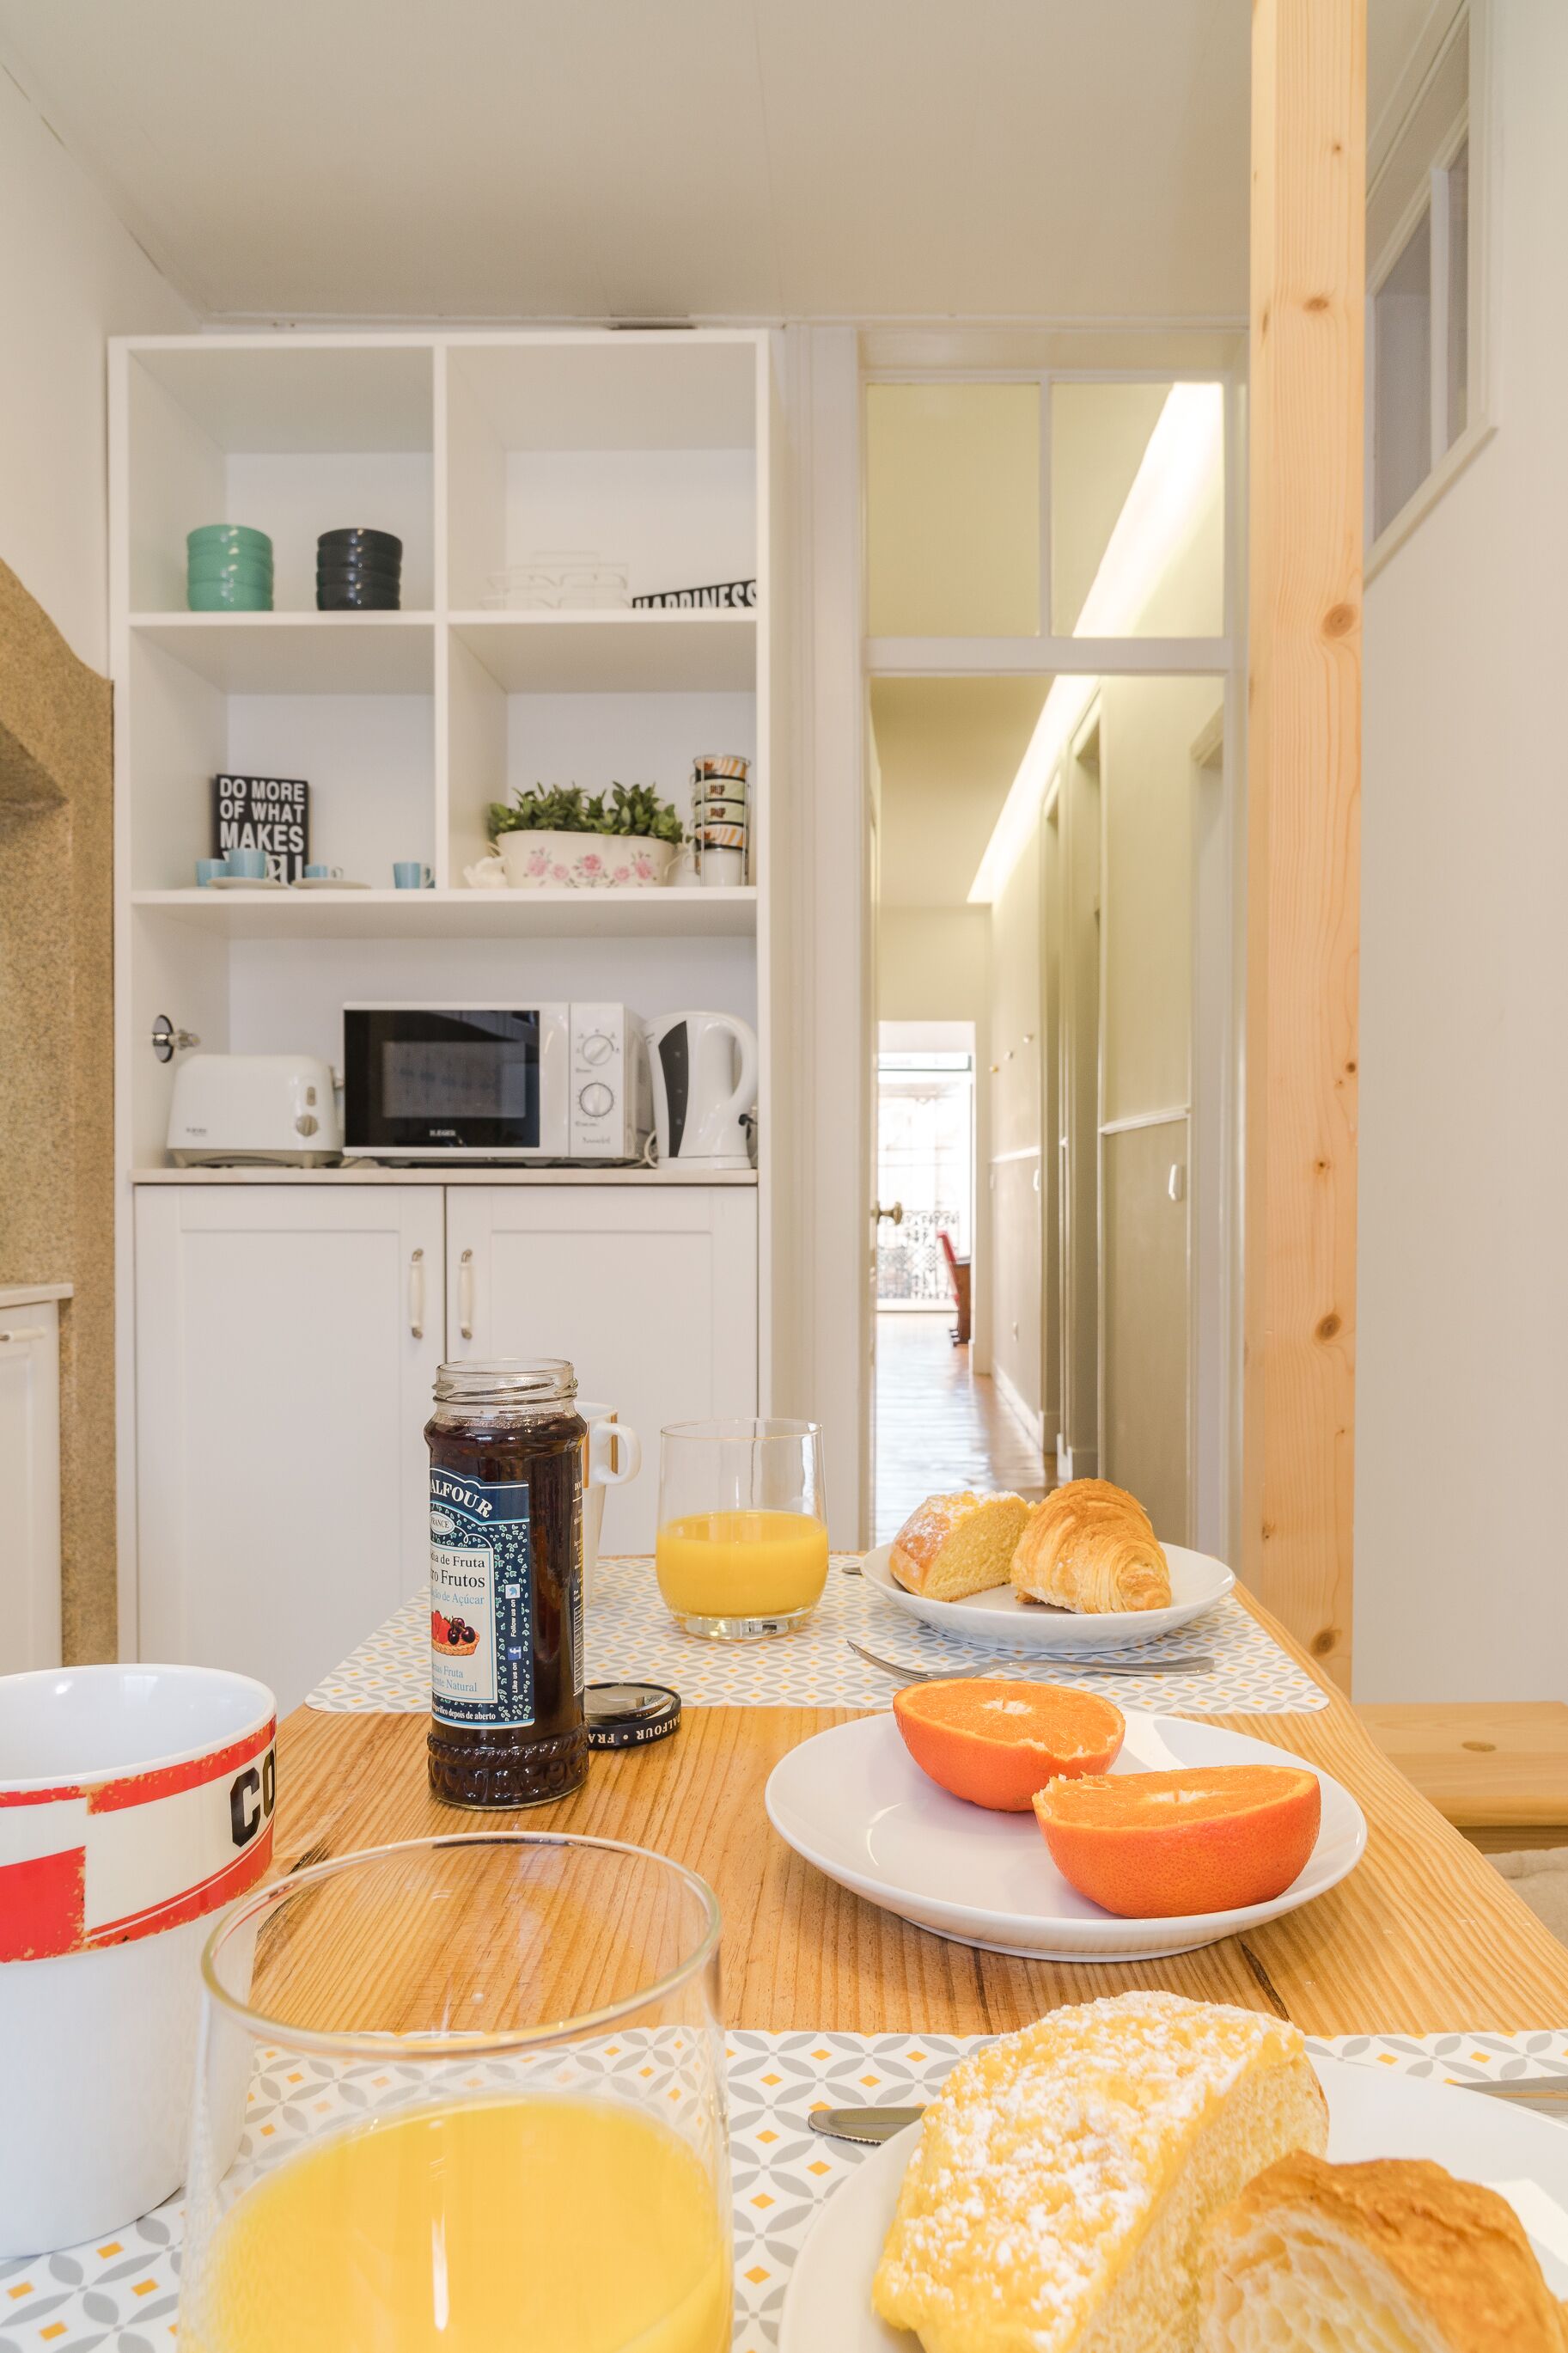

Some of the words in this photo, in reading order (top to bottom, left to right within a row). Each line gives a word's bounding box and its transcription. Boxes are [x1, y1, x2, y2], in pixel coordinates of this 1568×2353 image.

[220, 778, 247, 798] DO
[251, 779, 305, 803] MORE
[219, 798, 245, 820] OF
[251, 802, 305, 823] WHAT
[220, 821, 304, 853] MAKES
[441, 1554, 450, 1565] de
[453, 1555, 485, 1568] Fruta
[441, 1569, 485, 1588] Frutos
[442, 1590, 450, 1601] de
[452, 1592, 485, 1606] Açúcar
[510, 1599, 516, 1608] on
[510, 1608, 516, 1617] us
[443, 1665, 464, 1678] Fruta
[512, 1662, 517, 1671] on
[446, 1679, 477, 1692] Natural
[448, 1708, 465, 1720] depois
[466, 1711, 473, 1720] de
[474, 1711, 496, 1720] aberto
